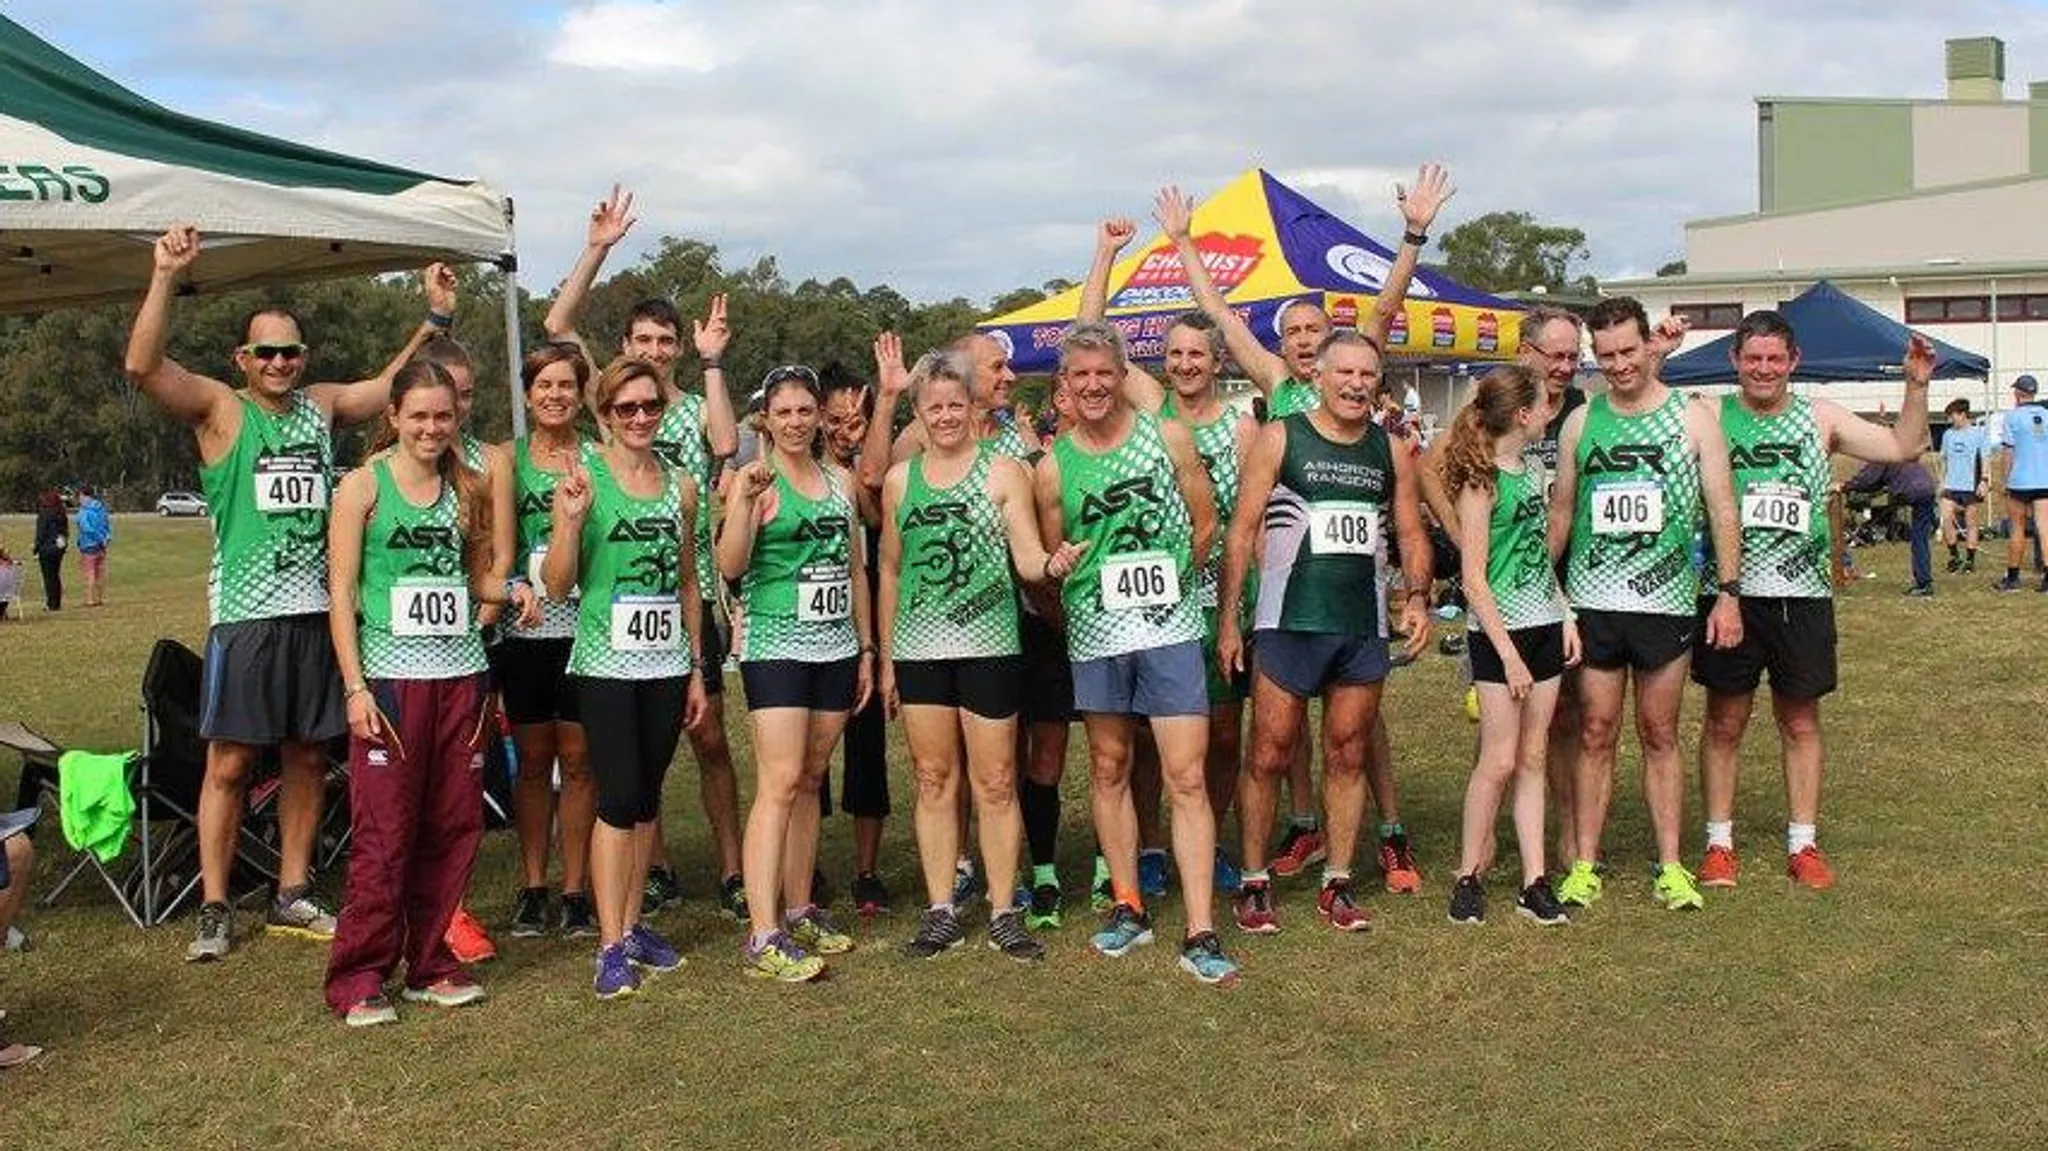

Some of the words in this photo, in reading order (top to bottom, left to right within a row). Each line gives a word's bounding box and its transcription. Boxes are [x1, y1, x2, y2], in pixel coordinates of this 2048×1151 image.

[1583, 442, 1667, 475] ASR
[1730, 441, 1807, 470] ASR
[268, 477, 314, 504] 407
[1080, 477, 1163, 525] ASR
[902, 502, 974, 532] ASR
[1603, 495, 1648, 523] 406
[1752, 500, 1800, 526] 408
[386, 521, 458, 551] ASR
[605, 514, 680, 542] ASR
[1324, 514, 1369, 545] 408
[1117, 565, 1165, 598] 406
[408, 592, 456, 625] 403
[809, 585, 848, 616] 405
[627, 610, 671, 641] 405
